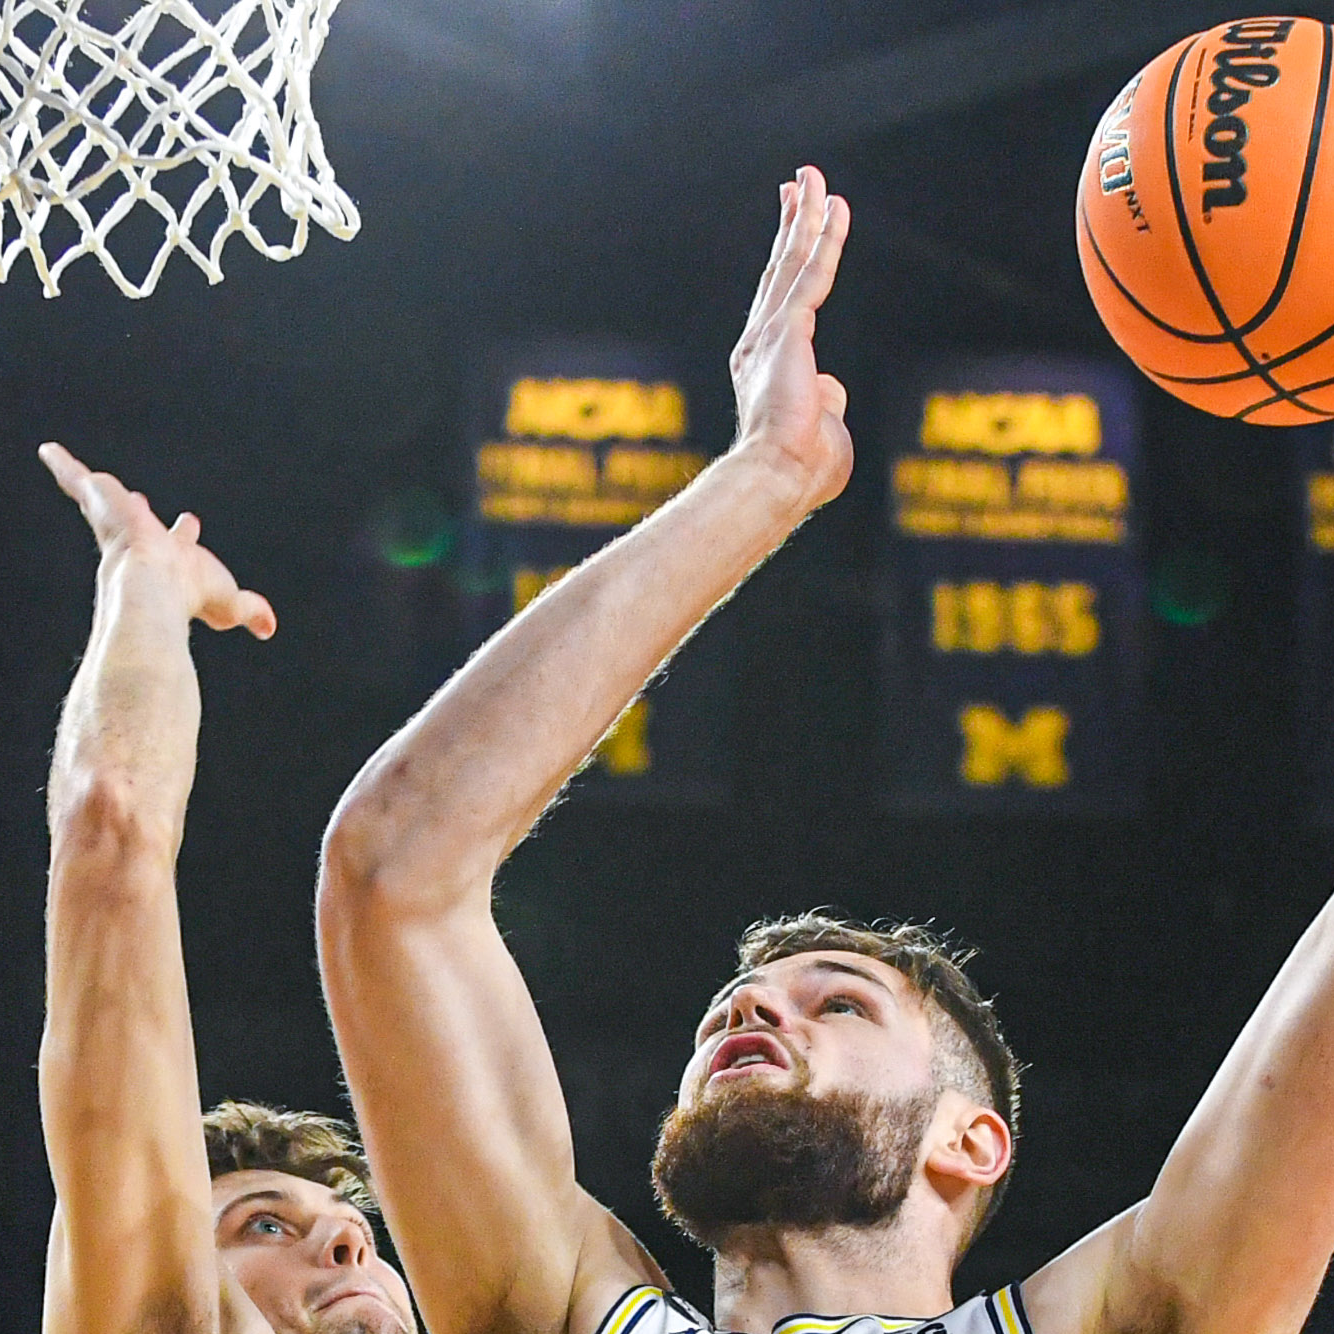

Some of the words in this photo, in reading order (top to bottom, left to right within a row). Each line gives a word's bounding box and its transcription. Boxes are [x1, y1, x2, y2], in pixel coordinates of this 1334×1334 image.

[1202, 19, 1296, 214] Wilson
[1124, 190, 1152, 234] NXT
[958, 703, 1070, 788] M
